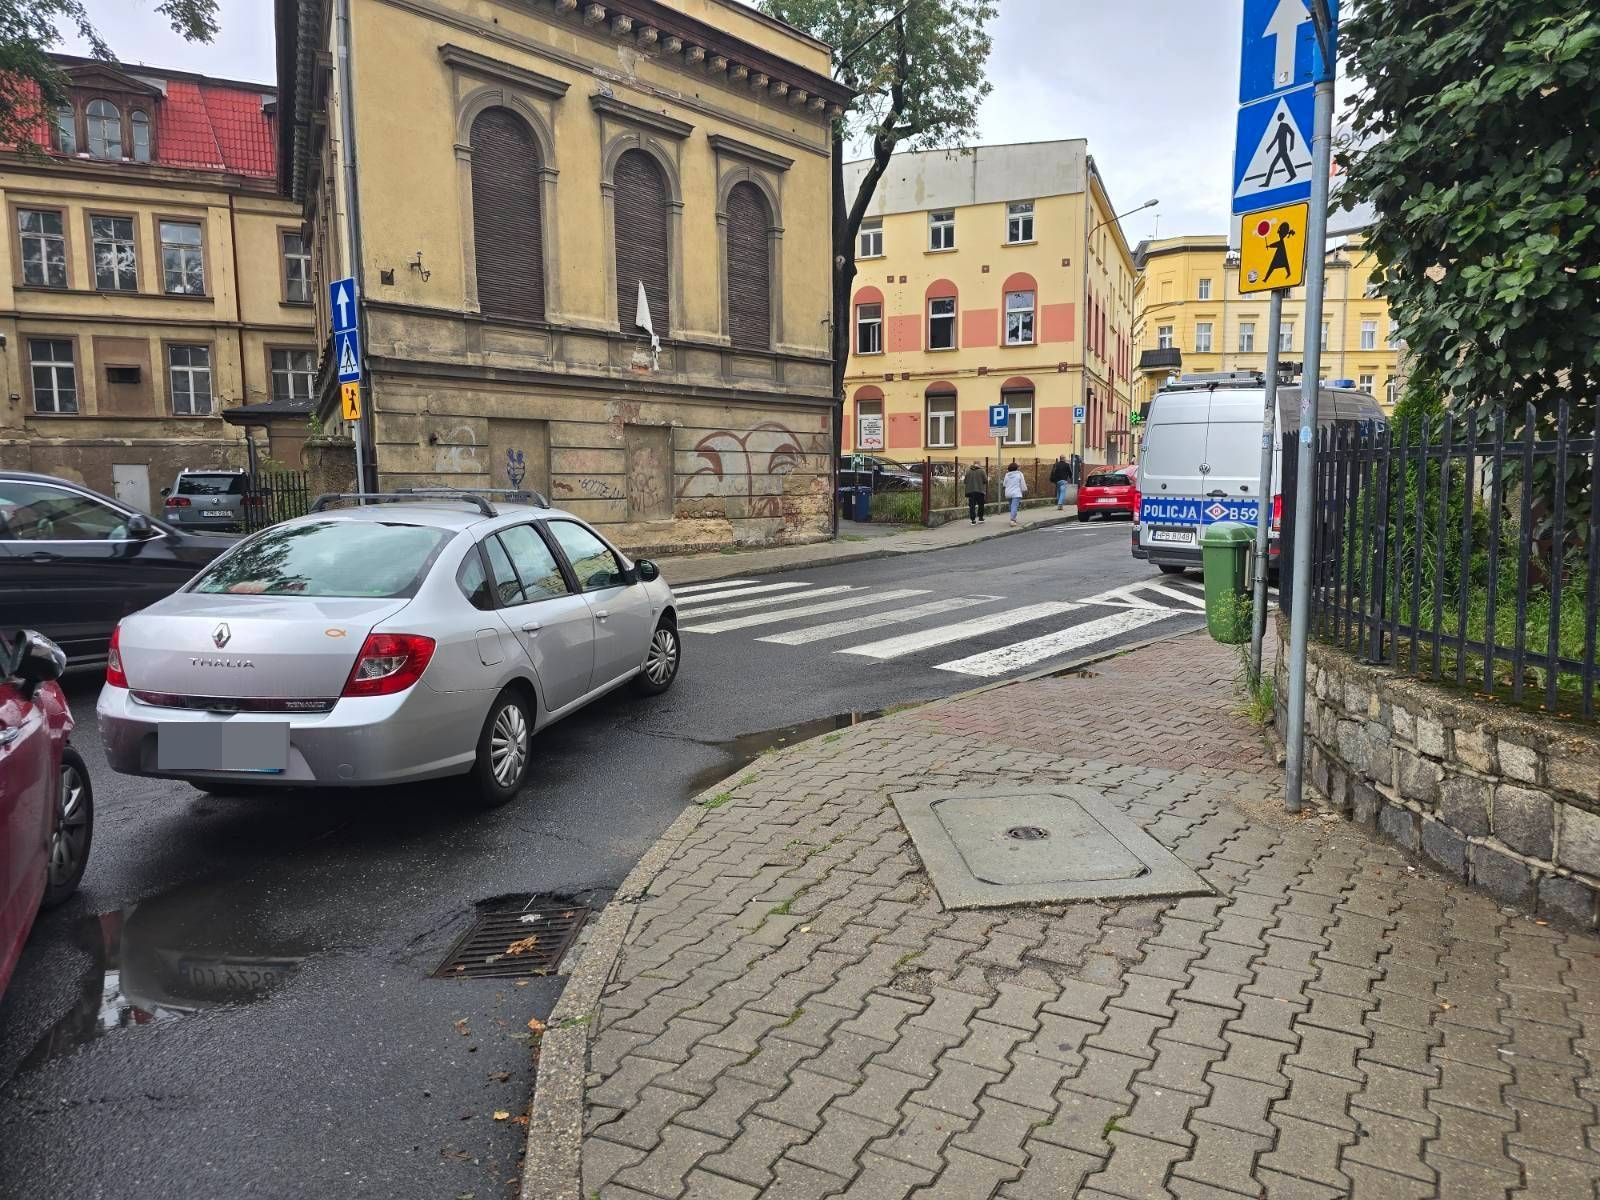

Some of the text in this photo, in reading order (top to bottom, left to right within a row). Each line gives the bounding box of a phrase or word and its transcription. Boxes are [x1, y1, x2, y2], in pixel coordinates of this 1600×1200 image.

[993, 407, 1005, 425] P
[1076, 408, 1083, 417] P
[1143, 504, 1197, 519] POLICJA
[1230, 507, 1259, 520] B59
[188, 657, 256, 669] THALIA
